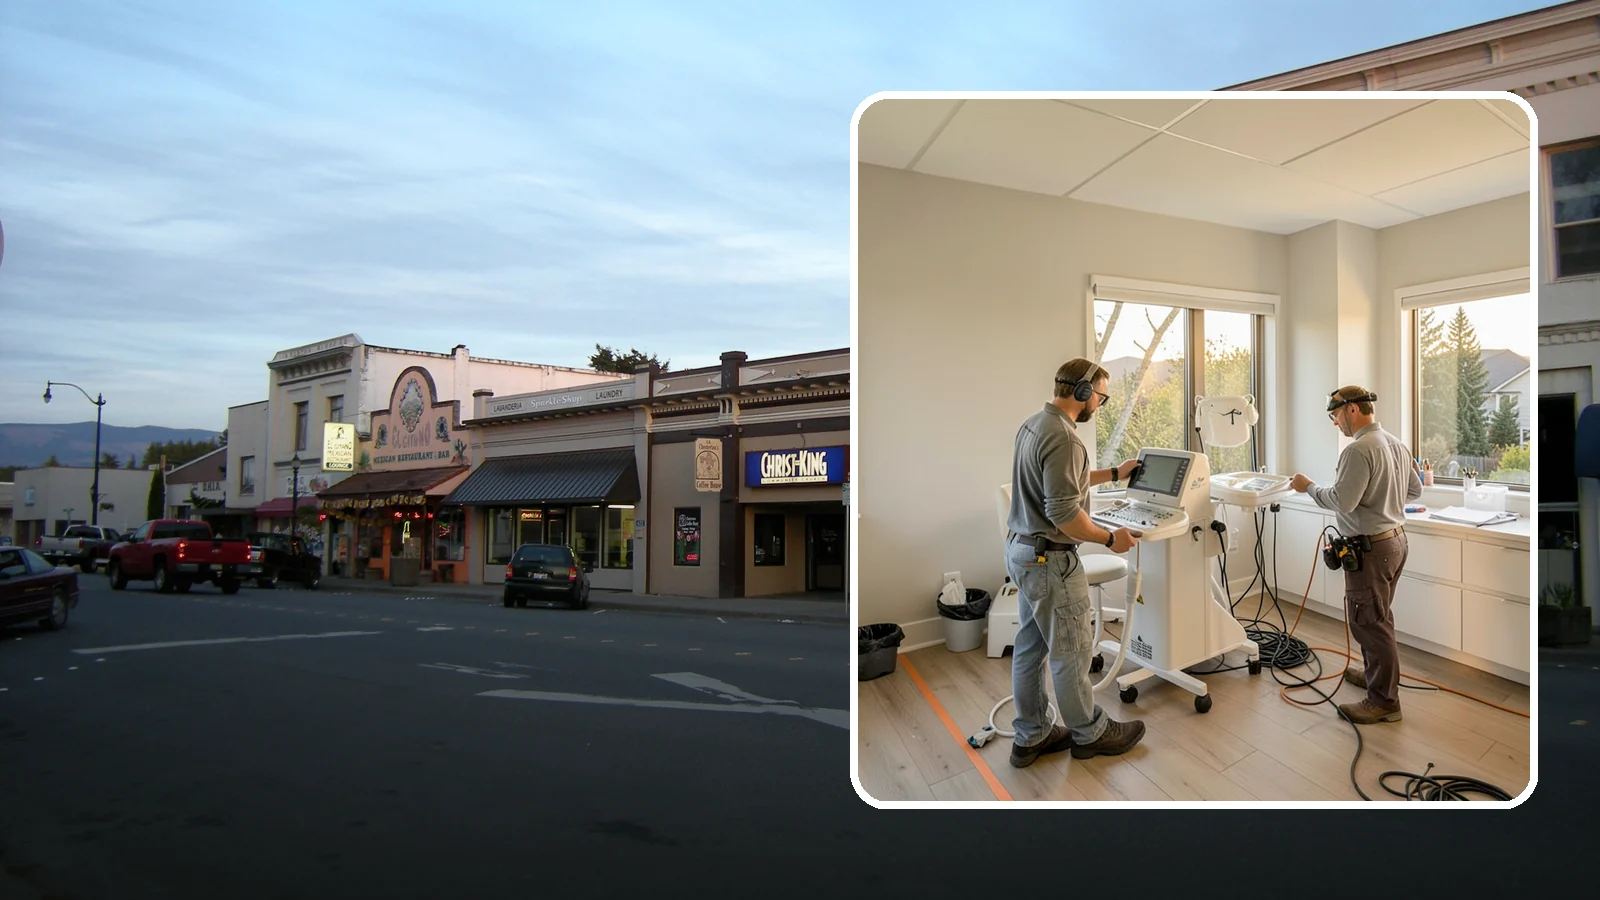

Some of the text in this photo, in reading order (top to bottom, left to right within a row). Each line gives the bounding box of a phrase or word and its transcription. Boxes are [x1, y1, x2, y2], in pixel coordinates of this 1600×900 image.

[595, 389, 623, 400] LAUNDRY
[561, 394, 583, 408] Shop
[493, 402, 522, 413] LAVANDERIA
[397, 451, 433, 462] RESTAURANT
[437, 450, 450, 459] BAR
[761, 449, 828, 478] CHRIST KING
